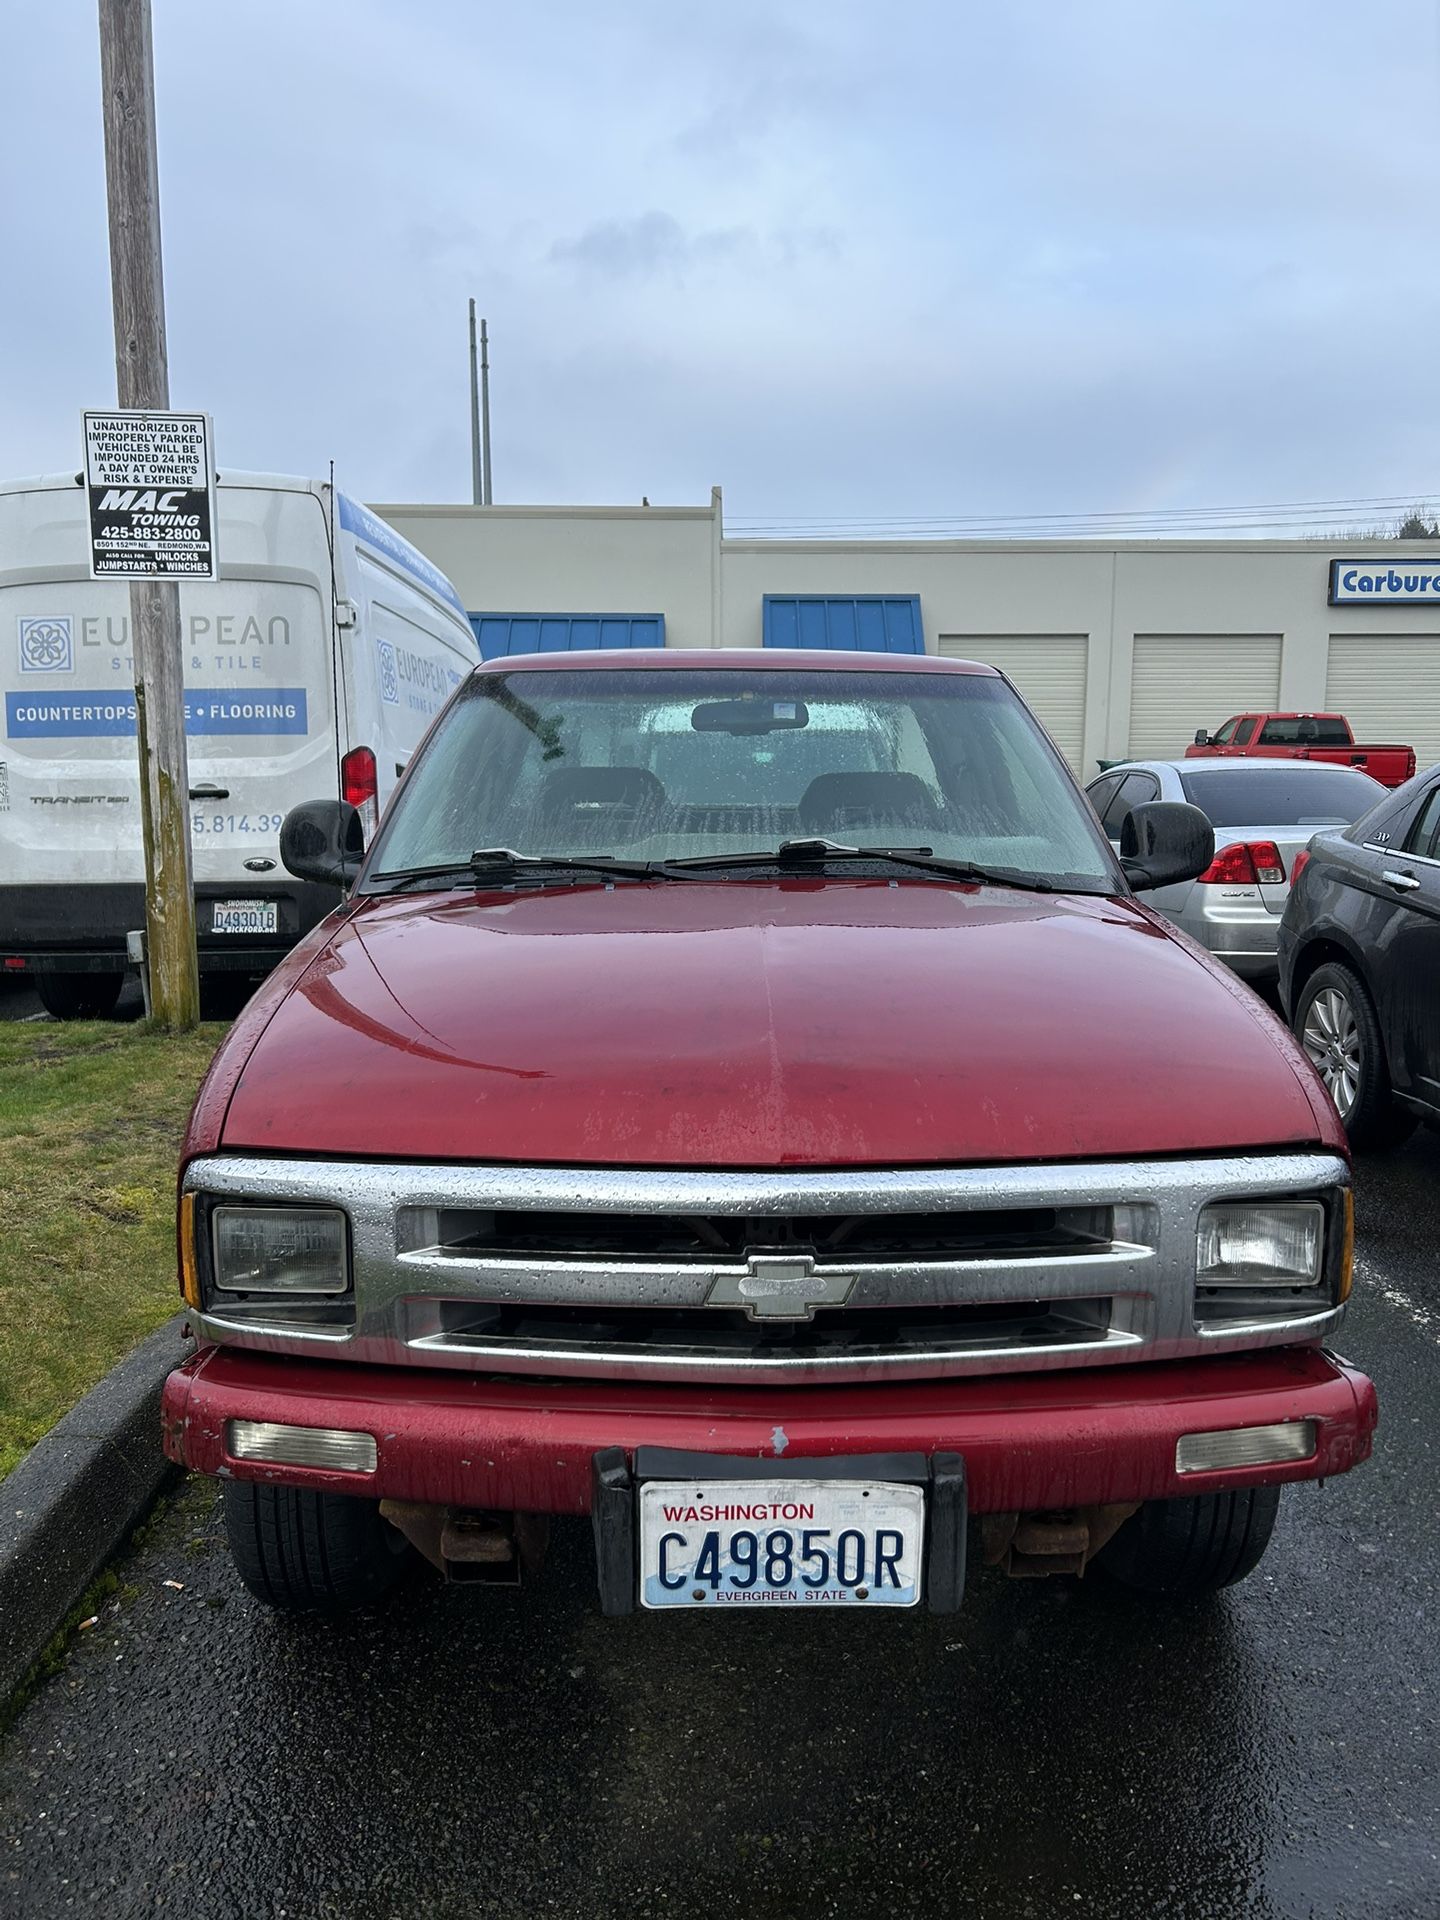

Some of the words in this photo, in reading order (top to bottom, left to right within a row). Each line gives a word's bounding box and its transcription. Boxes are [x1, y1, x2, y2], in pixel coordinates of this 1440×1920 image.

[93, 422, 178, 433] UNAUTHORIZED
[182, 424, 197, 433] OR
[89, 432, 157, 443] IMPROPERLY
[160, 434, 203, 444] PARKED
[97, 442, 150, 453] VEHICLES
[153, 444, 179, 453] WILL
[182, 445, 196, 454] BE
[94, 453, 159, 463] IMPOUNDED
[162, 454, 175, 463] 24
[178, 455, 200, 464] HRS
[98, 463, 106, 472] A
[109, 464, 129, 473] DAY
[133, 464, 146, 473] AT
[149, 465, 198, 474] OWNER'S
[103, 474, 130, 483] RISK
[133, 475, 140, 484] &
[144, 475, 193, 485] EXPENSE
[98, 489, 187, 512] MAC
[131, 514, 200, 527] TOWING
[101, 526, 201, 541] 425-883-2800
[155, 552, 199, 561] UNLOCKS
[96, 561, 158, 570] JUMPSTARTS
[167, 562, 209, 571] WINCHES
[82, 616, 290, 646] EUPEAN
[192, 656, 202, 669] &
[215, 656, 262, 669] TILE
[16, 705, 137, 722] COUNTERTOPS
[210, 704, 297, 719] FLOORING
[30, 796, 106, 804] TRANSIT
[193, 815, 282, 833] 5.814.39
[664, 1504, 814, 1522] WASHINGTON
[658, 1530, 904, 1590] C49850R
[716, 1590, 797, 1601] EVERGREEN
[805, 1590, 847, 1601] STATE
